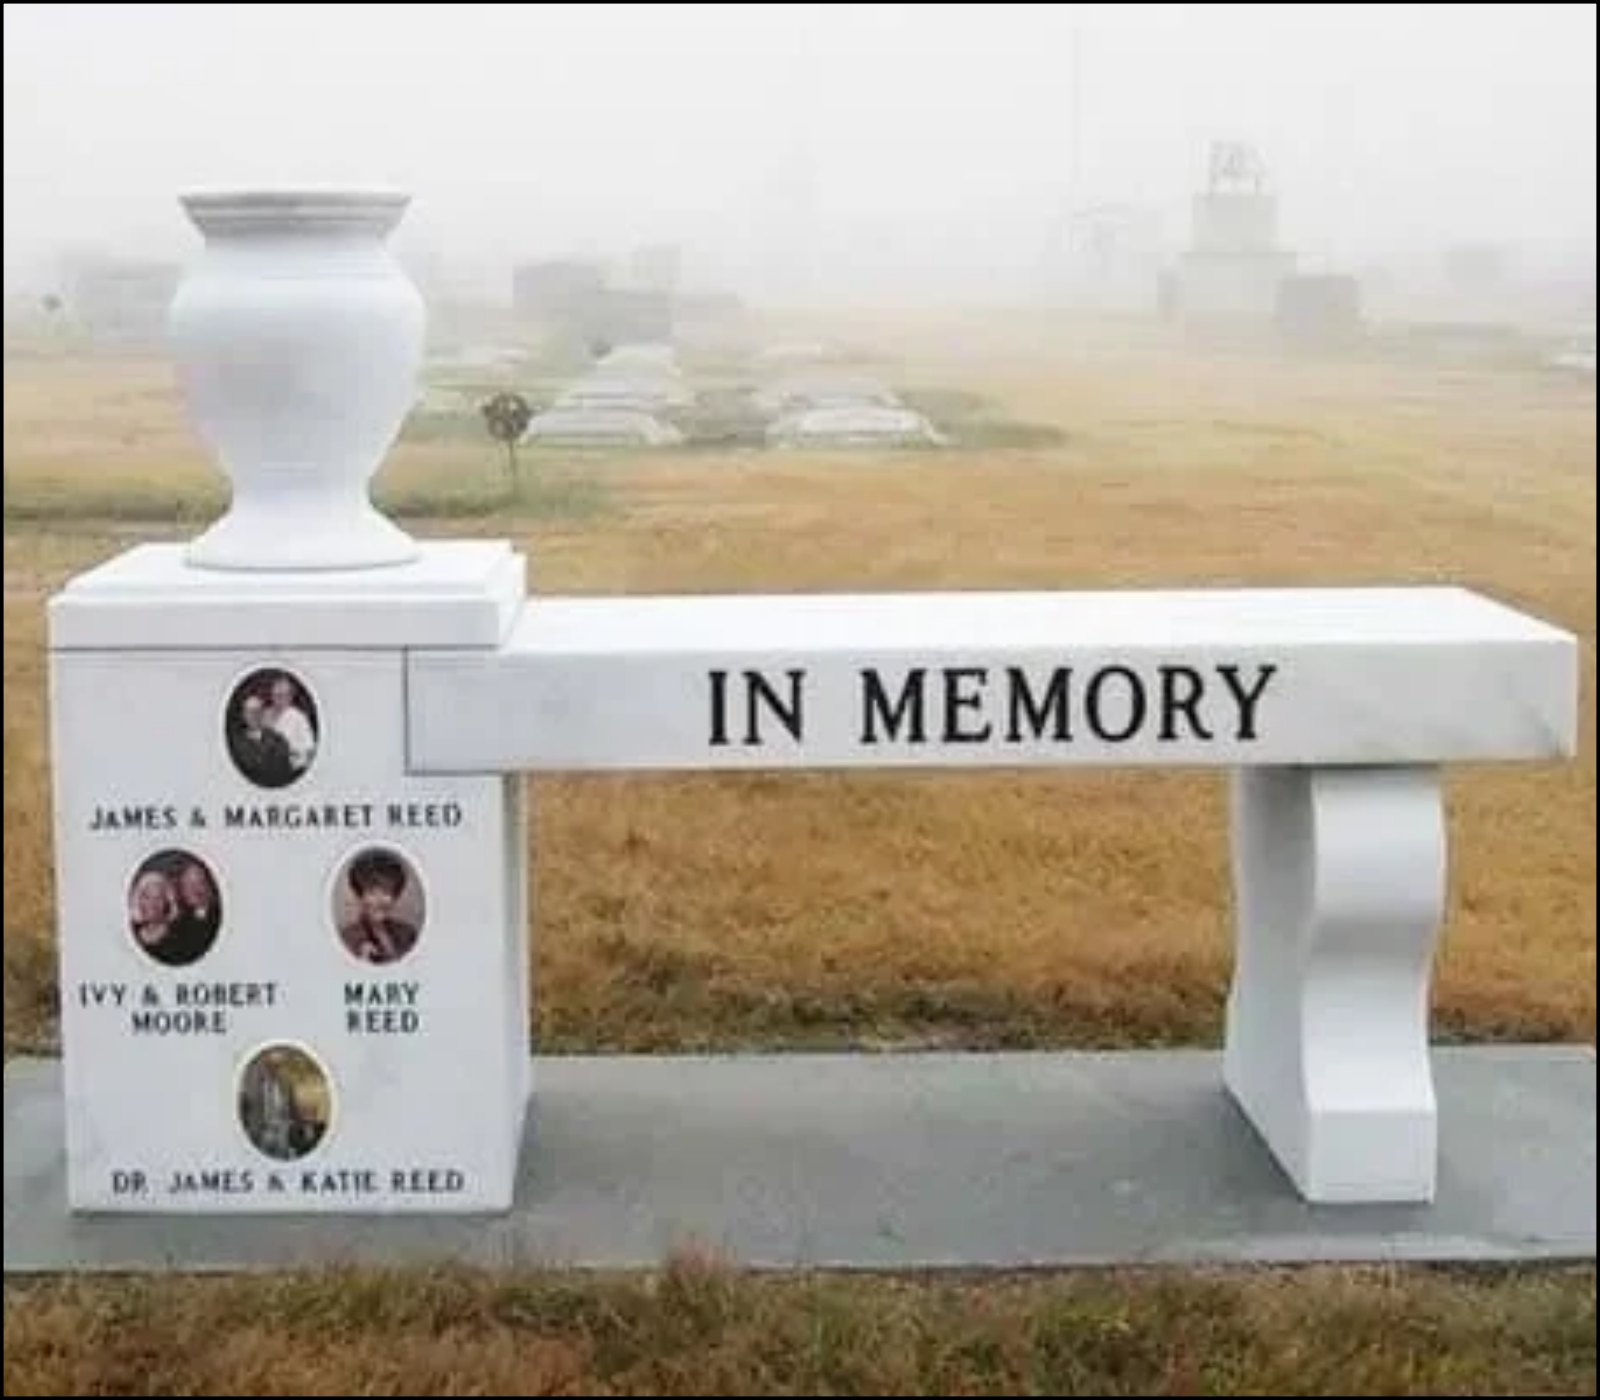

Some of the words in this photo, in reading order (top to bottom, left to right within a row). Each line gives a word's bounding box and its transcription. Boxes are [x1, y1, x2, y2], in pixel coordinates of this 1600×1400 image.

[708, 669, 805, 746] IN
[860, 665, 1279, 745] MEMORY
[90, 807, 177, 830] JAMES
[190, 808, 206, 828] &
[224, 804, 372, 828] MARGARET
[387, 803, 463, 827] REED
[79, 983, 126, 1008] IVY
[142, 985, 160, 1006] &
[176, 982, 277, 1007] ROBERT
[344, 982, 420, 1005] MARY
[131, 1010, 227, 1035] MOORE
[347, 1010, 420, 1033] REED
[168, 1170, 255, 1194] JAMES
[301, 1170, 377, 1193] KATIE
[391, 1169, 464, 1193] REED
